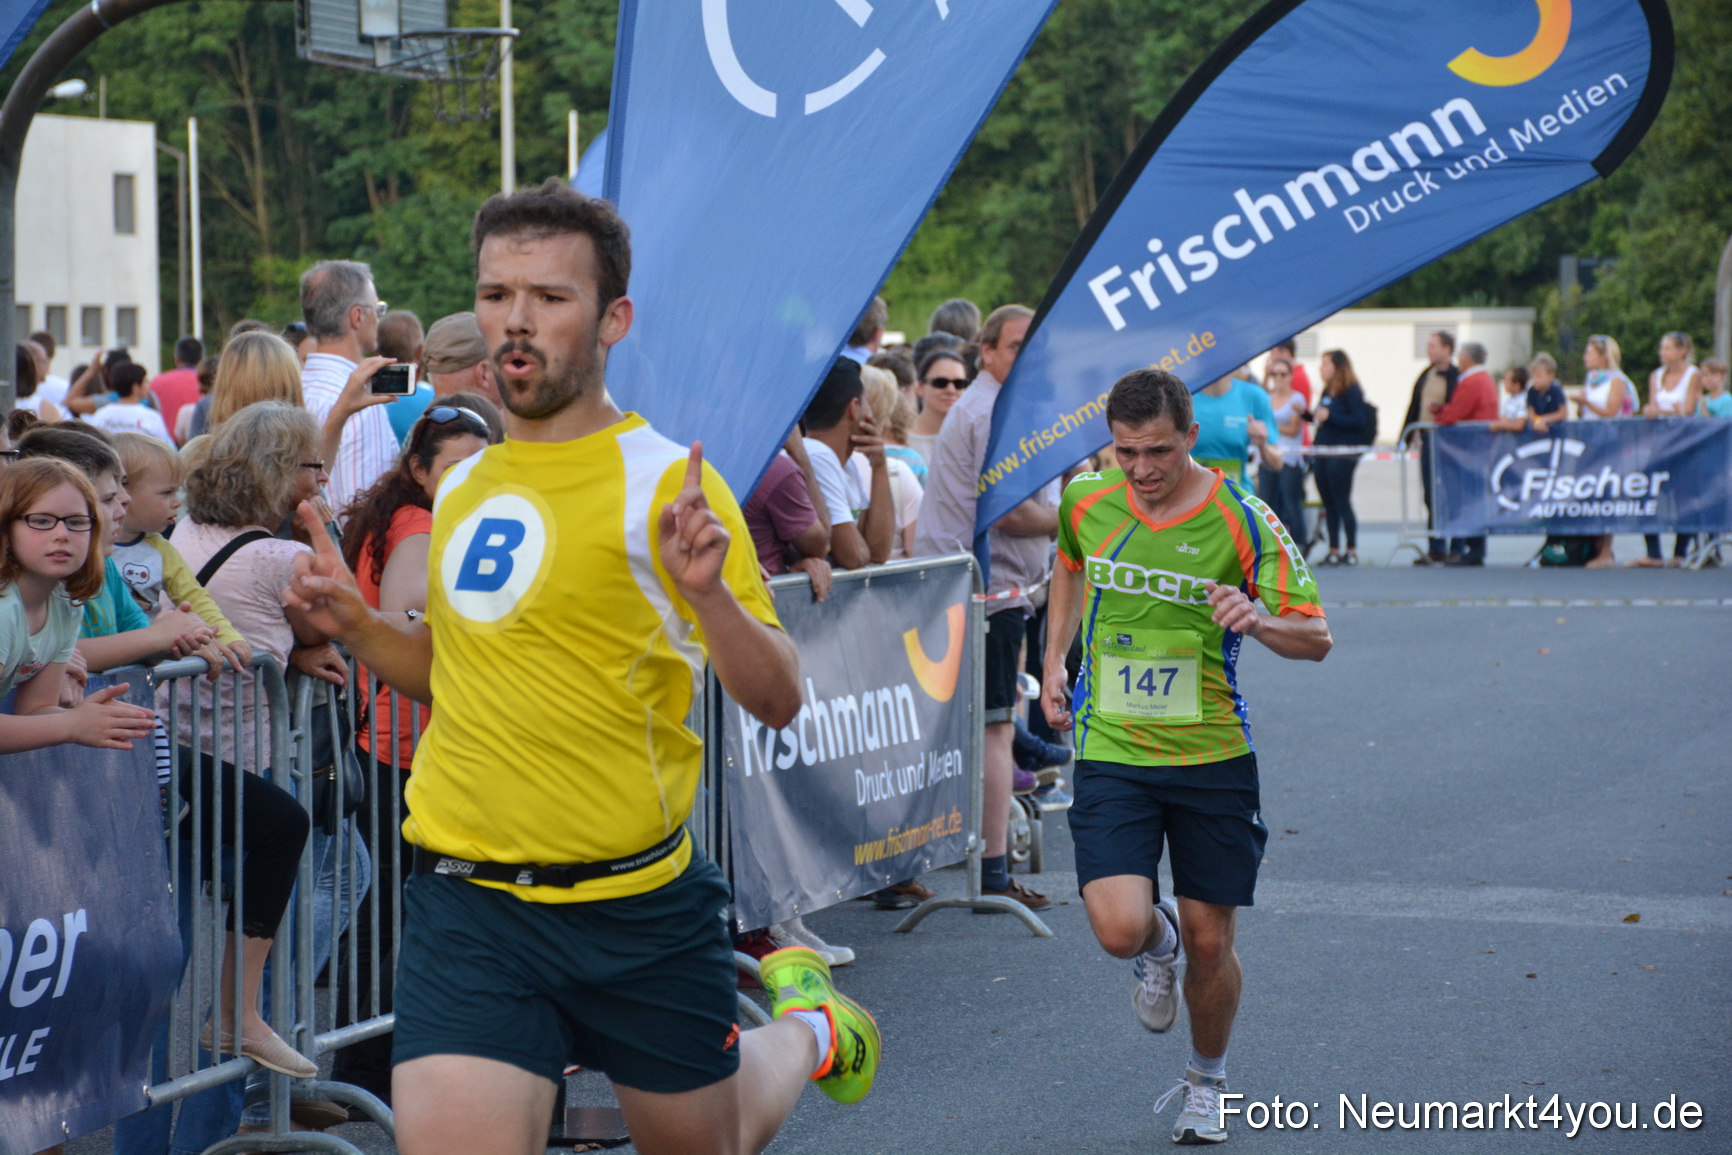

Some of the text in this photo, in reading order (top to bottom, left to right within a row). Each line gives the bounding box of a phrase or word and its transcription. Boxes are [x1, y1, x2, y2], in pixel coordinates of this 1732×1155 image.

[1343, 73, 1629, 233] Druck und Medien
[1088, 98, 1487, 331] Frischmann
[1520, 466, 1670, 501] Fischer
[1529, 500, 1658, 518] AUTOMOBILE
[454, 518, 526, 592] B
[1086, 555, 1219, 605] BOCK
[1118, 665, 1179, 697] 147
[855, 760, 895, 806] Druck
[896, 752, 925, 795] und
